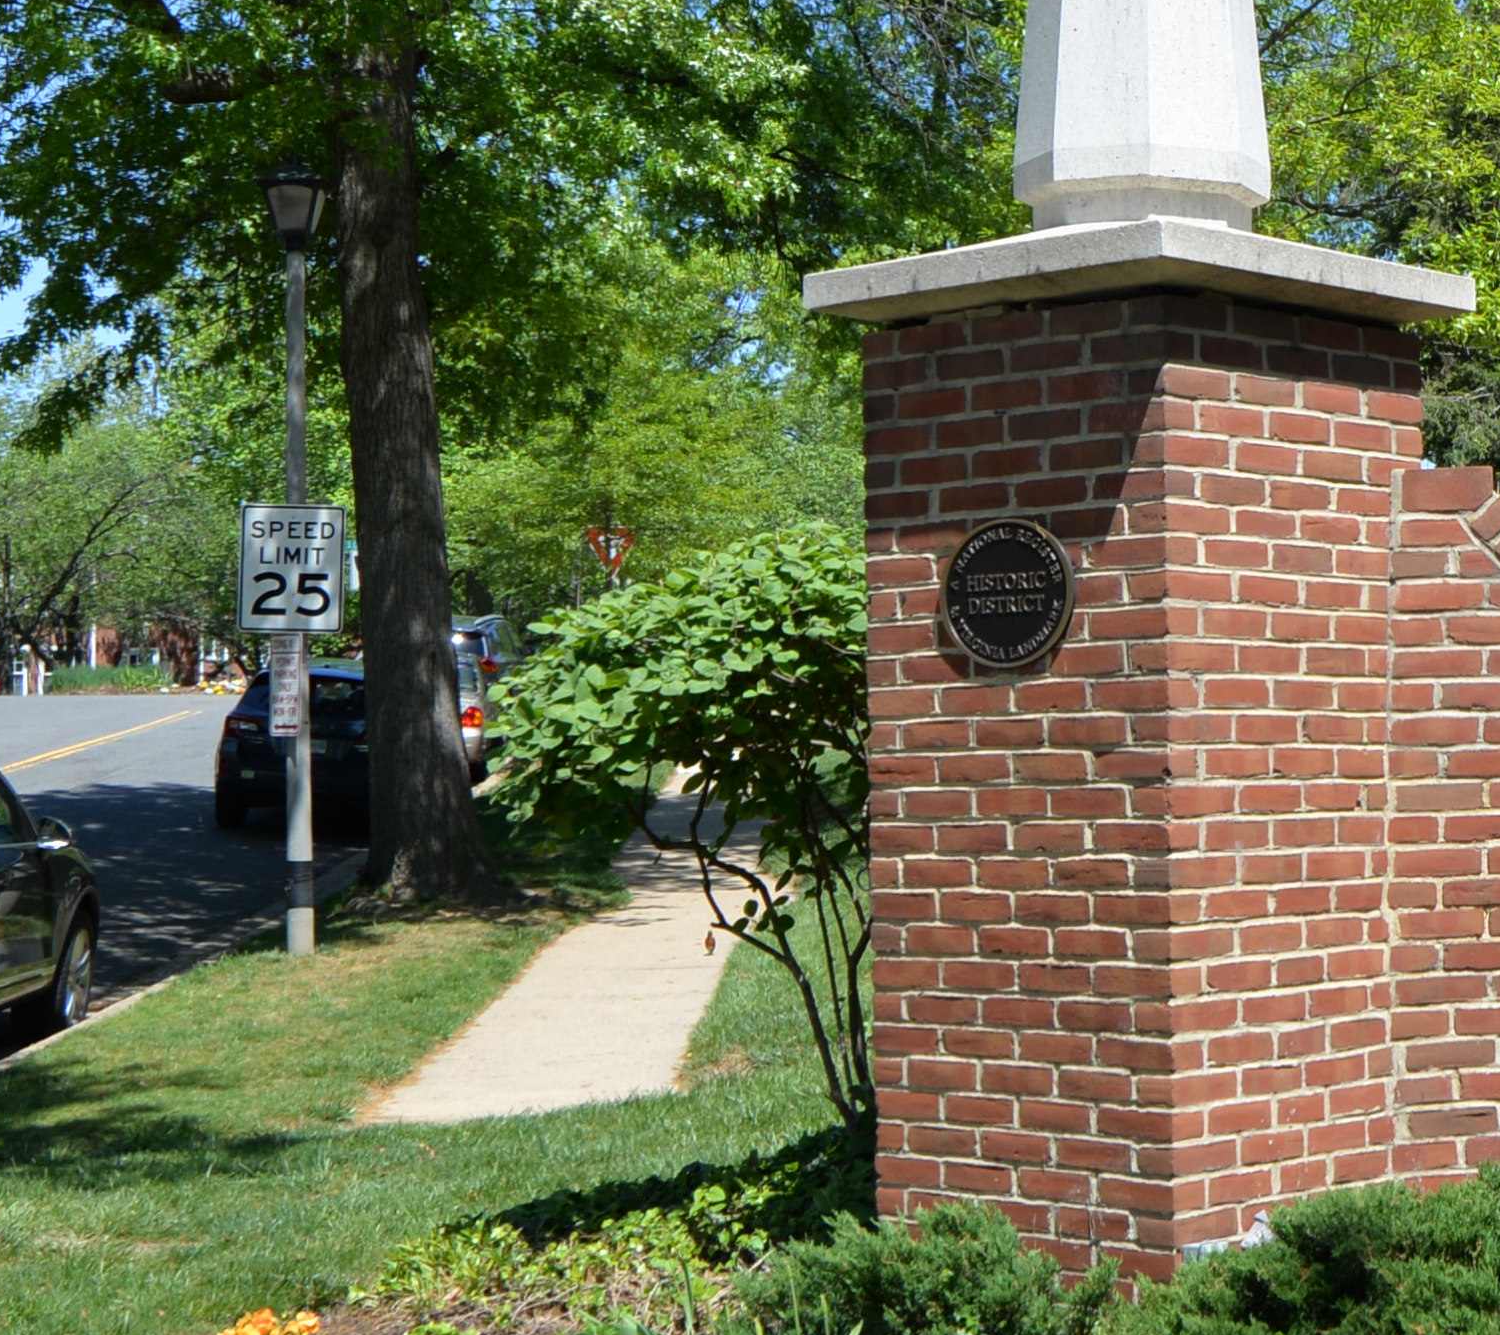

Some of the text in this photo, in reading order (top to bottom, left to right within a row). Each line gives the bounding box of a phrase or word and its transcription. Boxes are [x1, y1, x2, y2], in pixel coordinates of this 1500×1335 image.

[251, 521, 335, 540] SPEED
[260, 546, 325, 565] LIMIT
[956, 528, 1012, 573] NATIONAL
[1016, 528, 1063, 584] REGISTER
[966, 571, 1047, 592] HISTORIC
[251, 571, 330, 616] 25
[967, 594, 1045, 614] DISTRICT
[1010, 599, 1063, 659] LANDMARK
